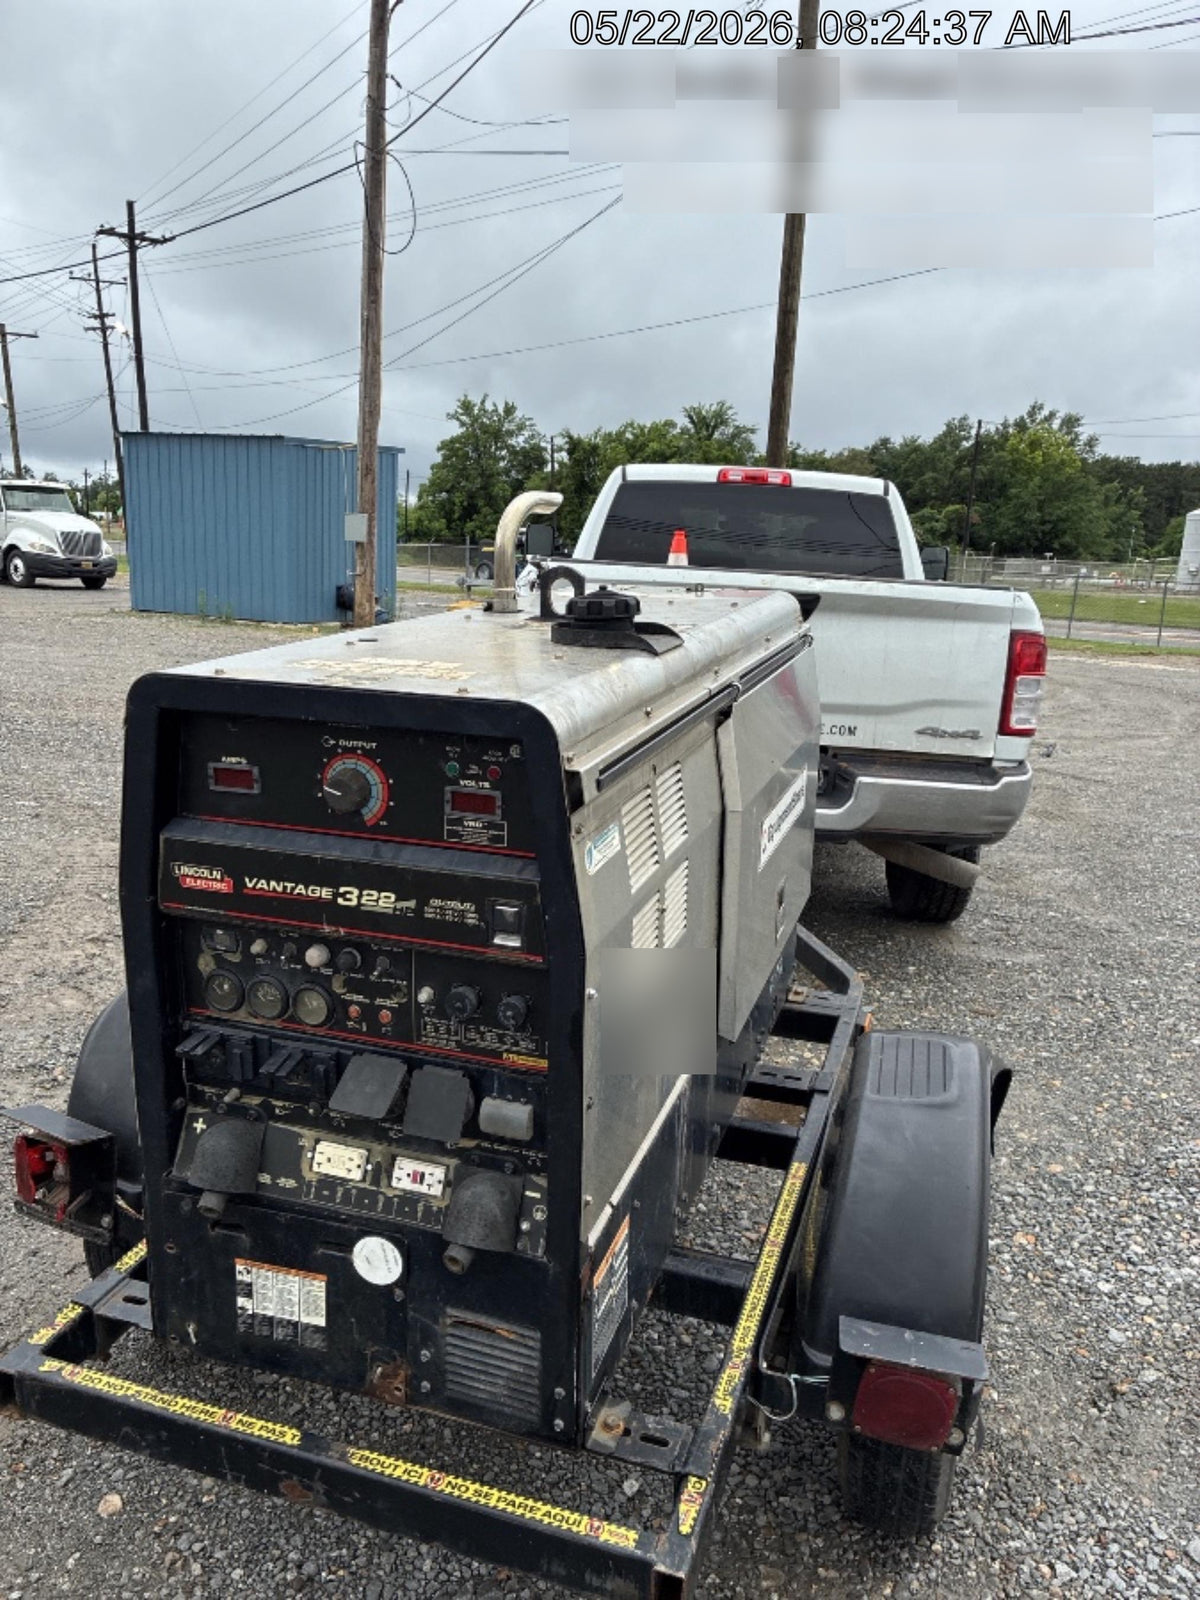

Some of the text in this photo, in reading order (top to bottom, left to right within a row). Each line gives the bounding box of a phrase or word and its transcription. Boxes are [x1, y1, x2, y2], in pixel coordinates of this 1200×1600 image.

[338, 739, 378, 750] OUTPUT
[459, 779, 491, 788] VOLTS
[174, 865, 222, 880] LINCOLN
[186, 877, 229, 890] ELECTRIC
[244, 876, 334, 899] VANTAGE
[337, 886, 396, 908] 322
[80, 1373, 102, 1385] DO
[102, 1380, 134, 1393] NOT
[133, 1389, 179, 1407] STAND
[179, 1402, 219, 1419] HERE
[236, 1418, 258, 1430] NE
[258, 1425, 288, 1439] PAS
[402, 1468, 424, 1480] ICI
[445, 1480, 470, 1494] NO
[472, 1489, 495, 1501] SE
[496, 1496, 541, 1515] PARE
